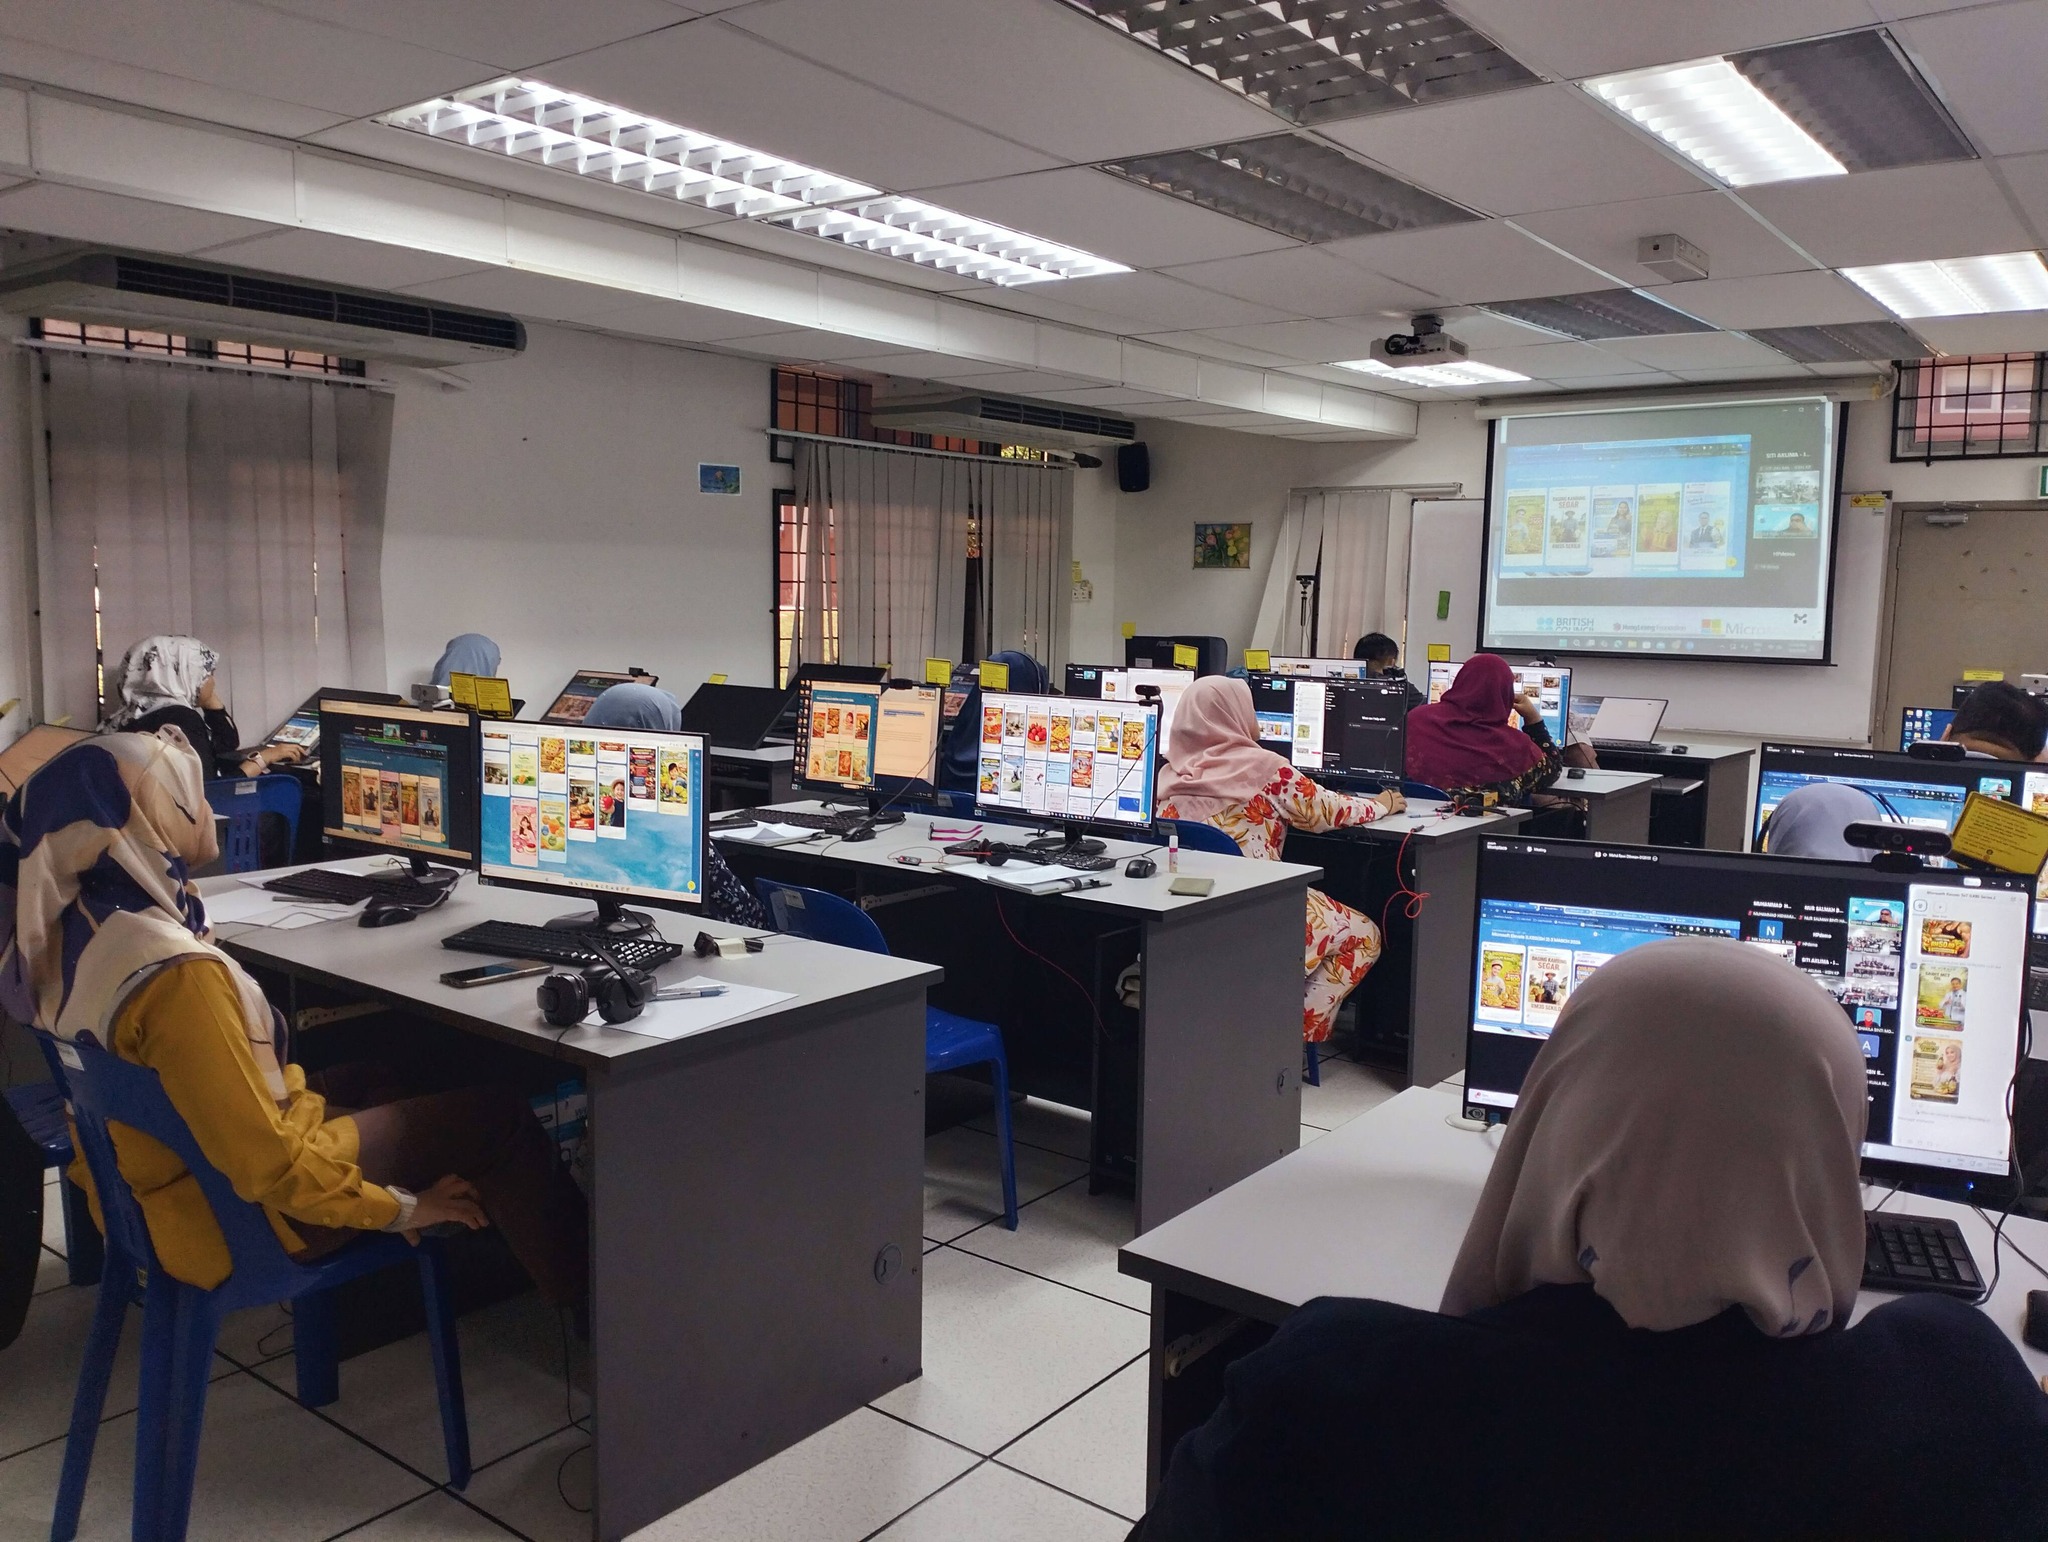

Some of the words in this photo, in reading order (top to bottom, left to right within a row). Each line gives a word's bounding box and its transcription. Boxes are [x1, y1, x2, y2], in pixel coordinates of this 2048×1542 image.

[1556, 617, 1594, 627] BRITISH
[1766, 925, 1775, 936] N
[1538, 962, 1560, 971] SEGAR
[1862, 1040, 1871, 1051] A
